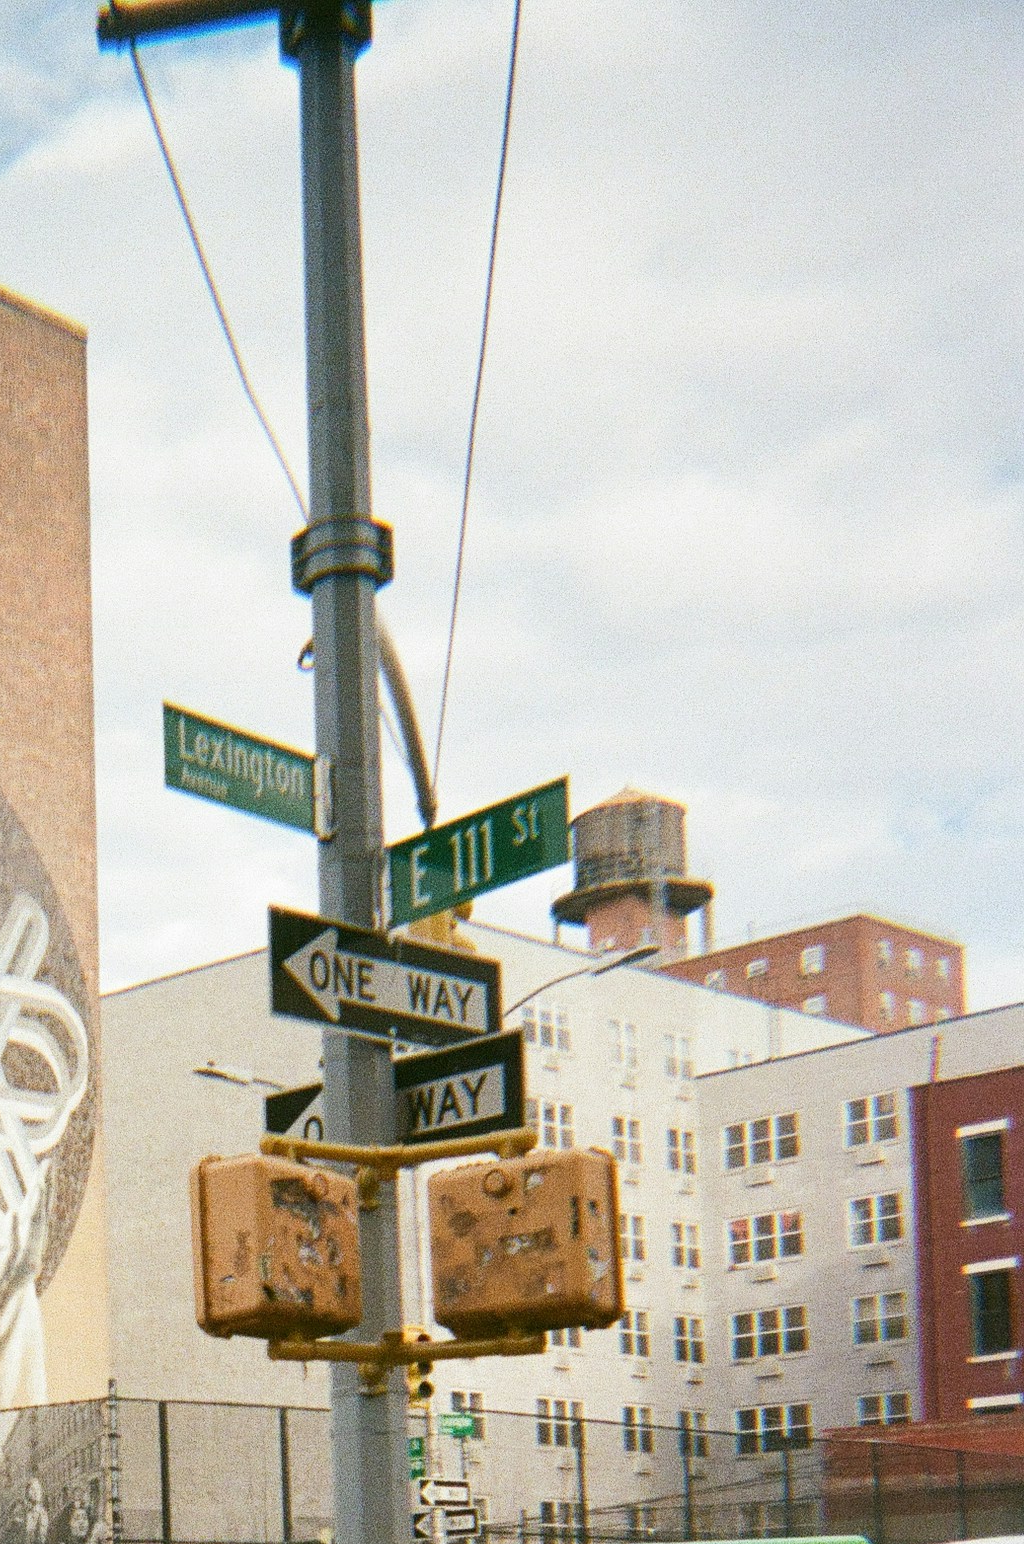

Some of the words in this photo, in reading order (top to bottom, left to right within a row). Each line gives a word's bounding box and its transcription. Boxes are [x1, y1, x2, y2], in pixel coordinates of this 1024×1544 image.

[178, 713, 304, 798] Lexington
[410, 842, 432, 908] E
[450, 816, 494, 892] 111
[512, 800, 540, 847] St
[309, 950, 376, 1001] ONE
[408, 973, 474, 1022] WAY
[411, 1071, 488, 1131] WAY
